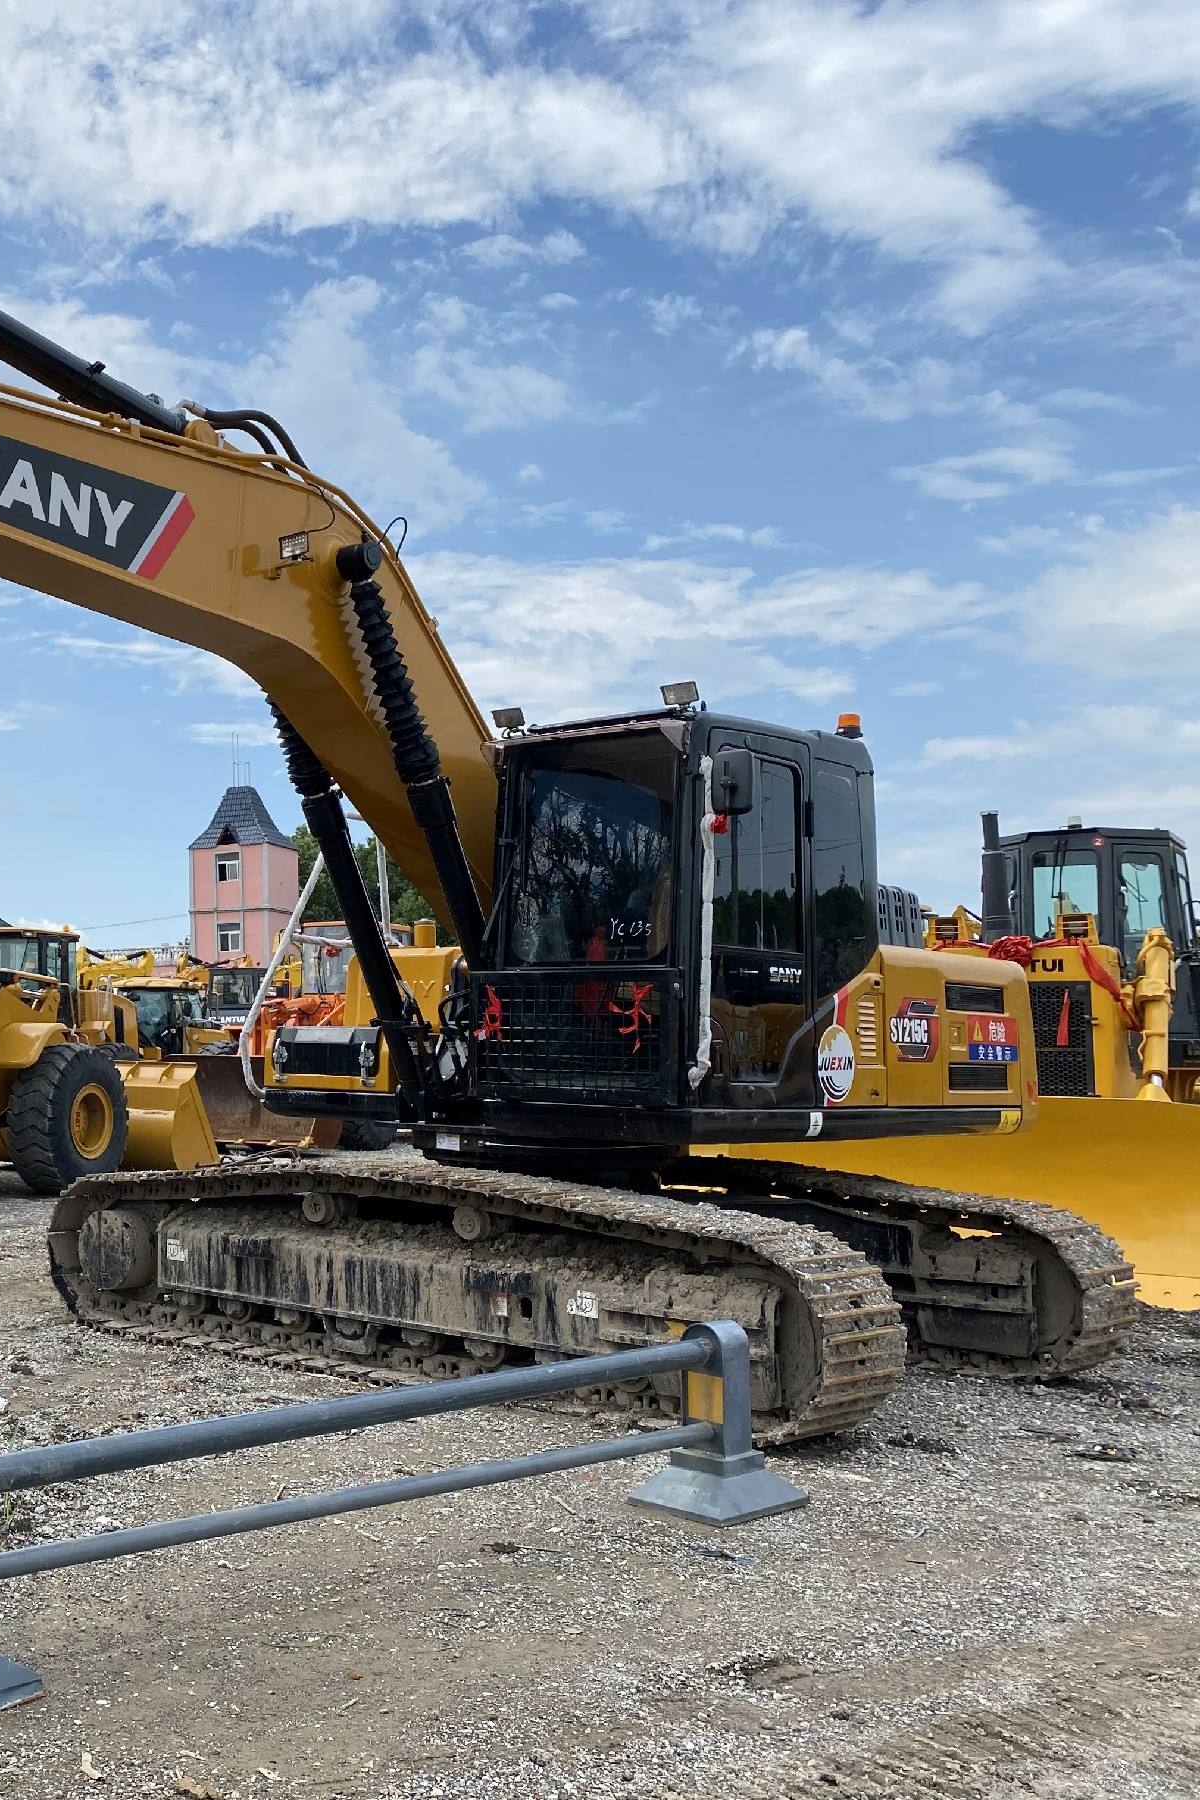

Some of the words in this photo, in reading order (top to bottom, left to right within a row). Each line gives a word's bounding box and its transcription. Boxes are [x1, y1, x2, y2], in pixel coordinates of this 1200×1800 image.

[769, 966, 802, 984] SANY
[890, 1017, 929, 1044] SY215C
[988, 1020, 1006, 1043] 危险
[978, 1045, 1012, 1061] 安全警示
[818, 1056, 855, 1072] JUEXIN
